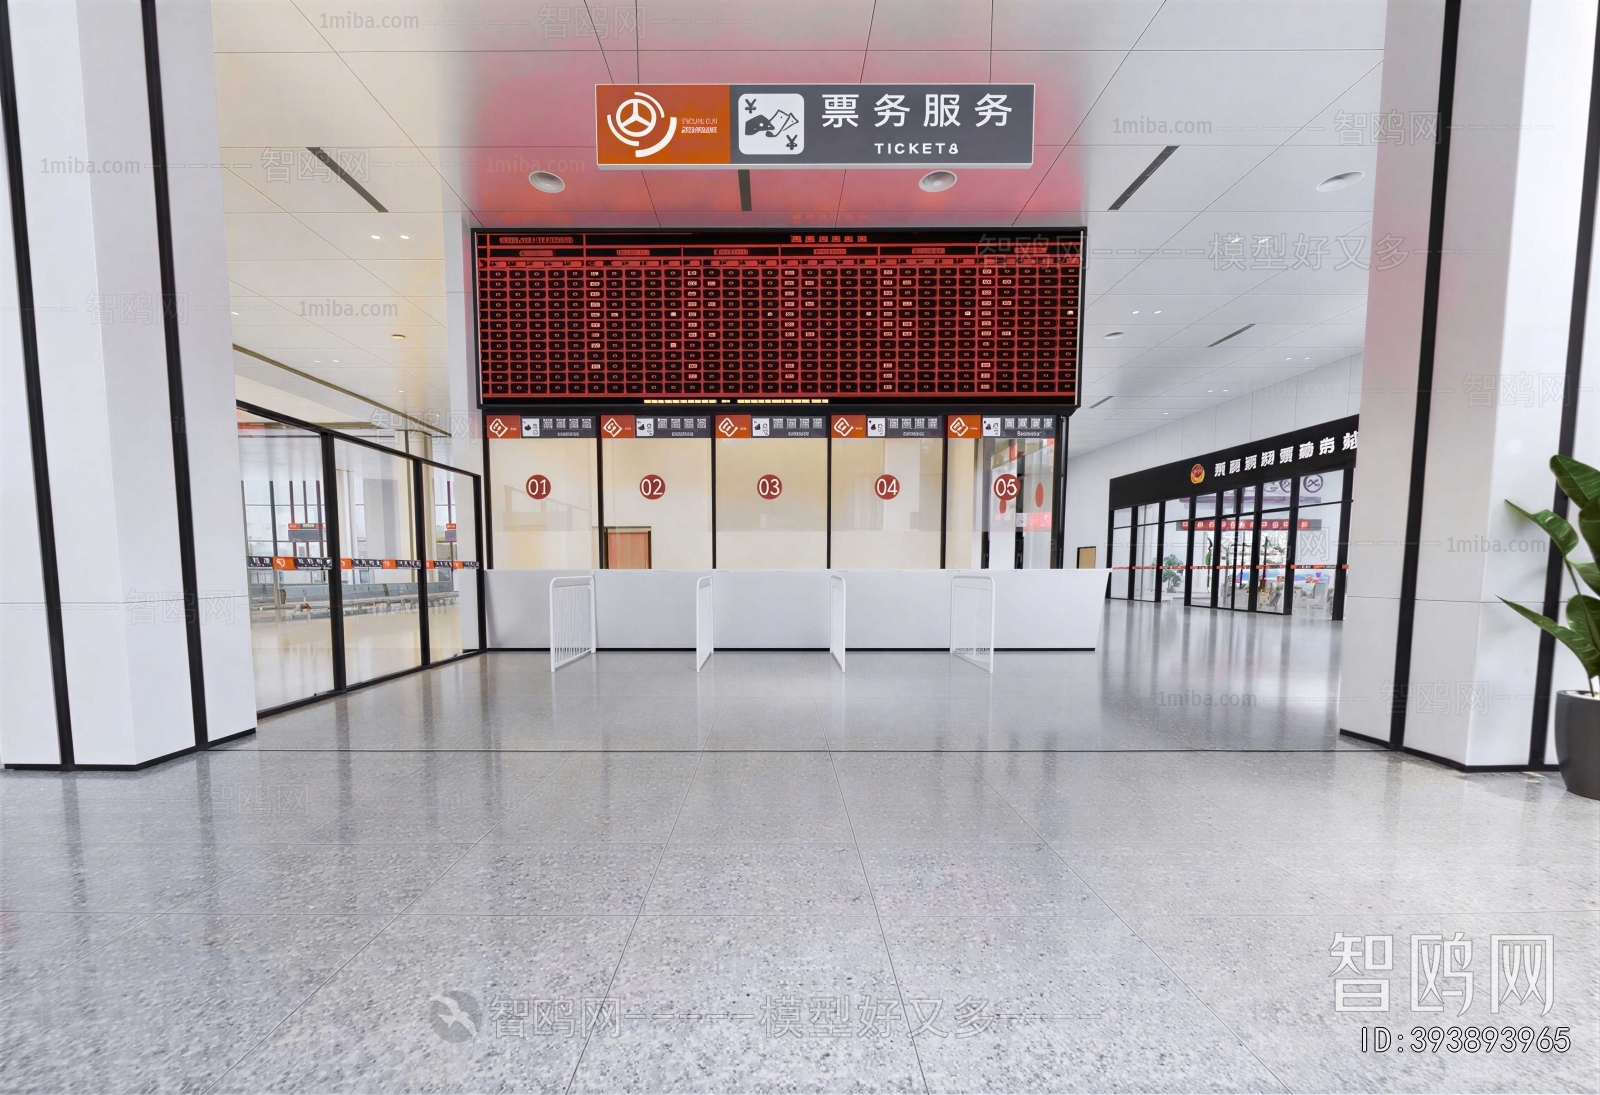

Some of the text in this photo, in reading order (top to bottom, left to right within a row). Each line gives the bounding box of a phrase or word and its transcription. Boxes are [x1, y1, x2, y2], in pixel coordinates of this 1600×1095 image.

[821, 93, 1013, 129] 票务服务
[527, 478, 547, 496] 01
[641, 478, 663, 496] 02
[758, 478, 781, 496] 03
[876, 478, 899, 496] 04
[995, 478, 1018, 496] 05
